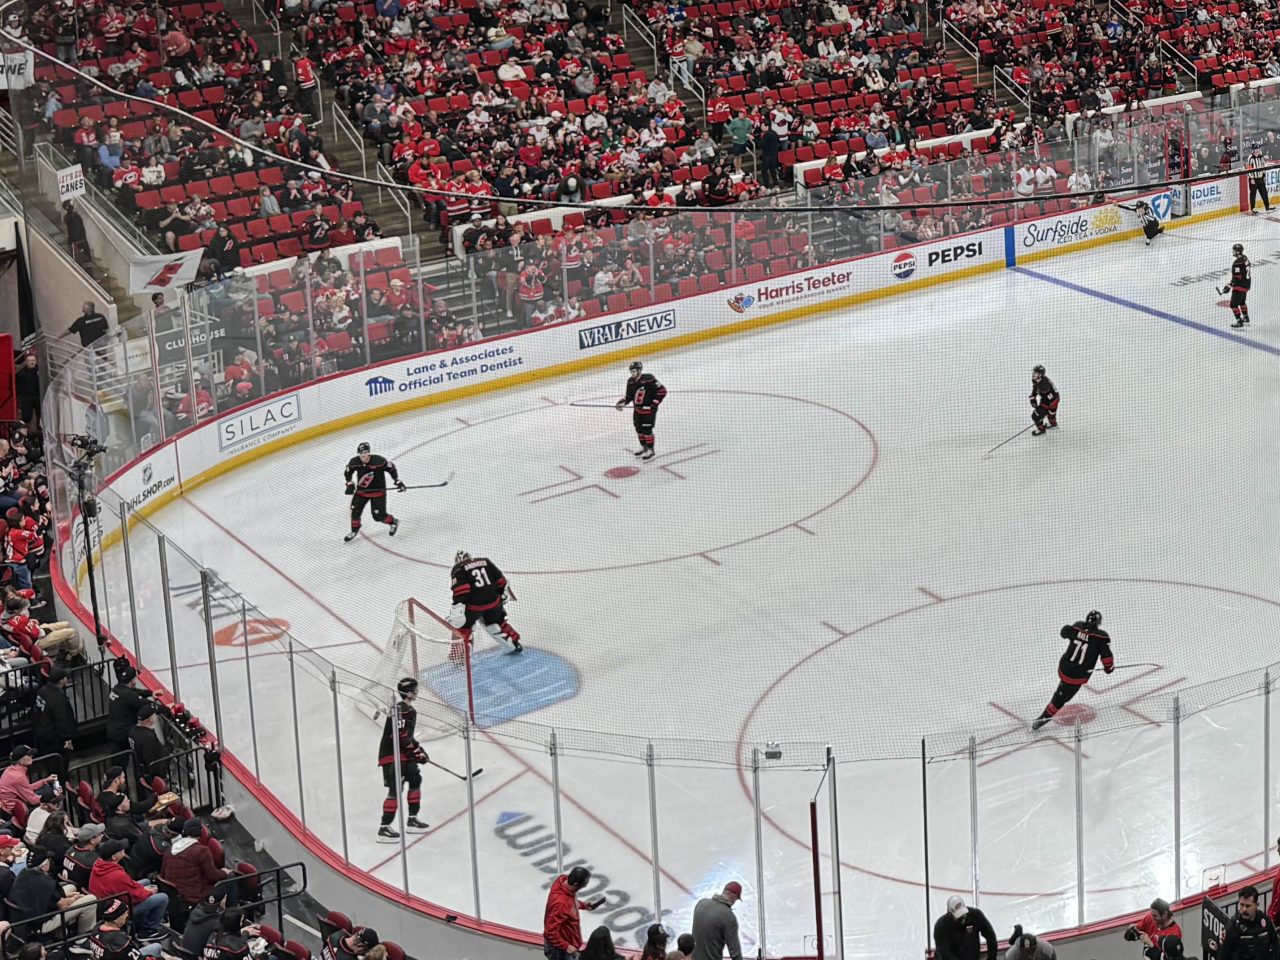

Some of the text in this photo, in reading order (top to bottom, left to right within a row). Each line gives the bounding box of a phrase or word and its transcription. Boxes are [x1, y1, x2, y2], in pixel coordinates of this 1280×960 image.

[60, 179, 85, 194] CANES
[1023, 216, 1089, 247] Surfside
[1075, 225, 1118, 240] TEA VODKA
[893, 259, 916, 271] PEPSI
[928, 241, 983, 267] PEPSI
[758, 271, 853, 302] Harris Teeter
[581, 313, 673, 349] WRAL NEWS
[398, 355, 523, 392] Official Team Dentist
[407, 343, 514, 378] Lane & Associates
[226, 401, 293, 441] SILAC
[471, 568, 491, 588] 31
[1070, 640, 1088, 665] 71
